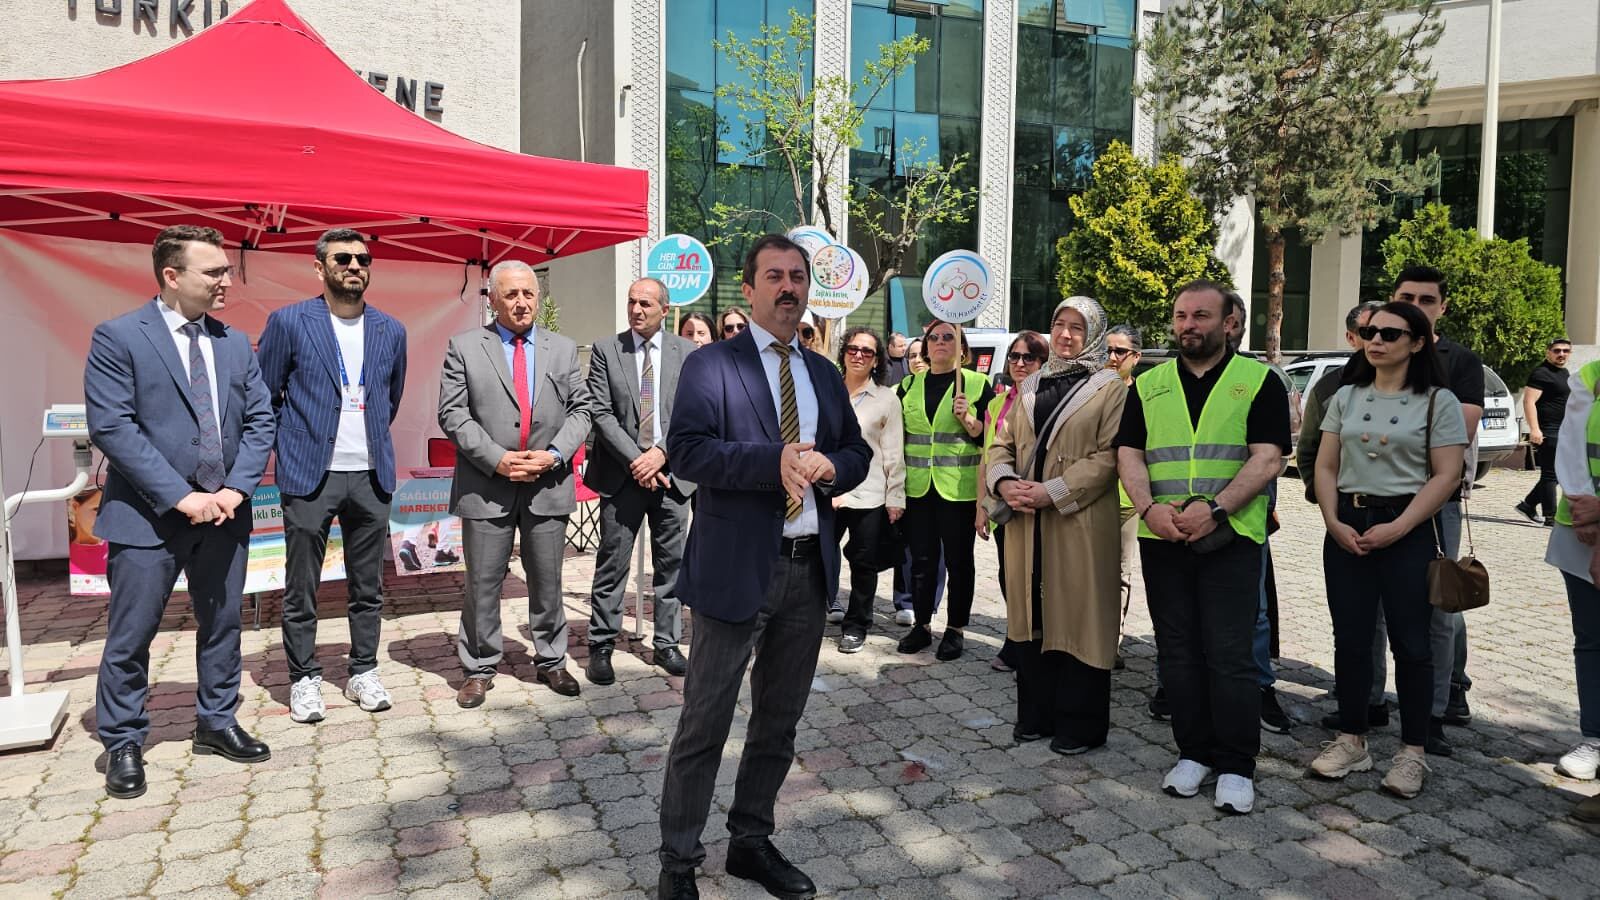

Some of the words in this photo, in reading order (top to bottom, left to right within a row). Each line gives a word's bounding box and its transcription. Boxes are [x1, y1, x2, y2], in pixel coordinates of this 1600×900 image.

[355, 69, 444, 114] ENE
[660, 252, 677, 261] HER
[675, 252, 700, 270] 10
[958, 300, 983, 318] Hareket
[399, 503, 449, 513] HAREKET
